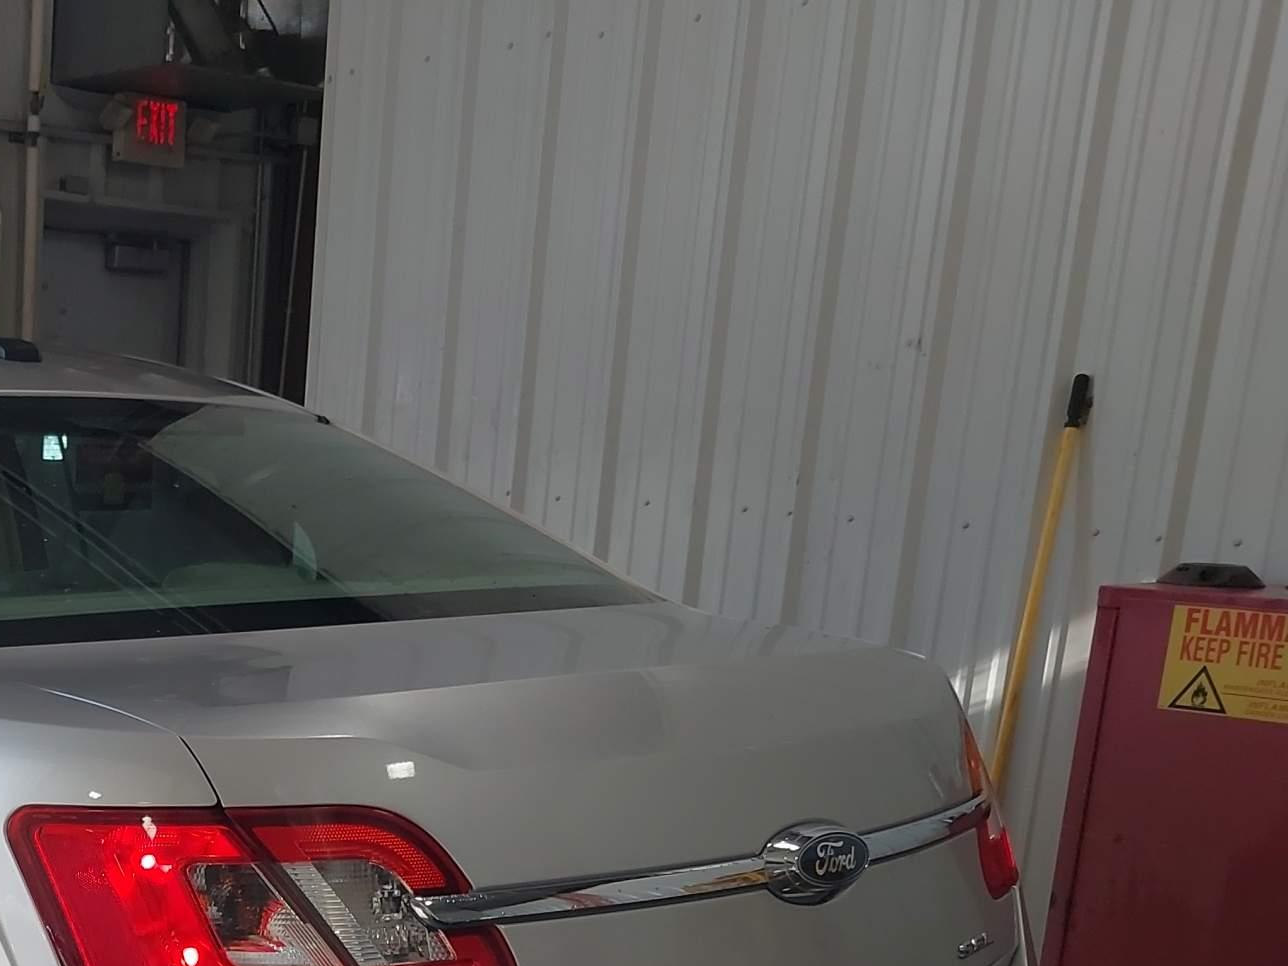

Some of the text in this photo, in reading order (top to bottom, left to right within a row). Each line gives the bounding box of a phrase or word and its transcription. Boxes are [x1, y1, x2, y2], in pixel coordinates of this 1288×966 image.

[136, 100, 178, 145] EXIT
[1184, 607, 1288, 643] FLAMM
[1179, 634, 1285, 671] KEEP FIRE
[815, 840, 857, 876] Ford
